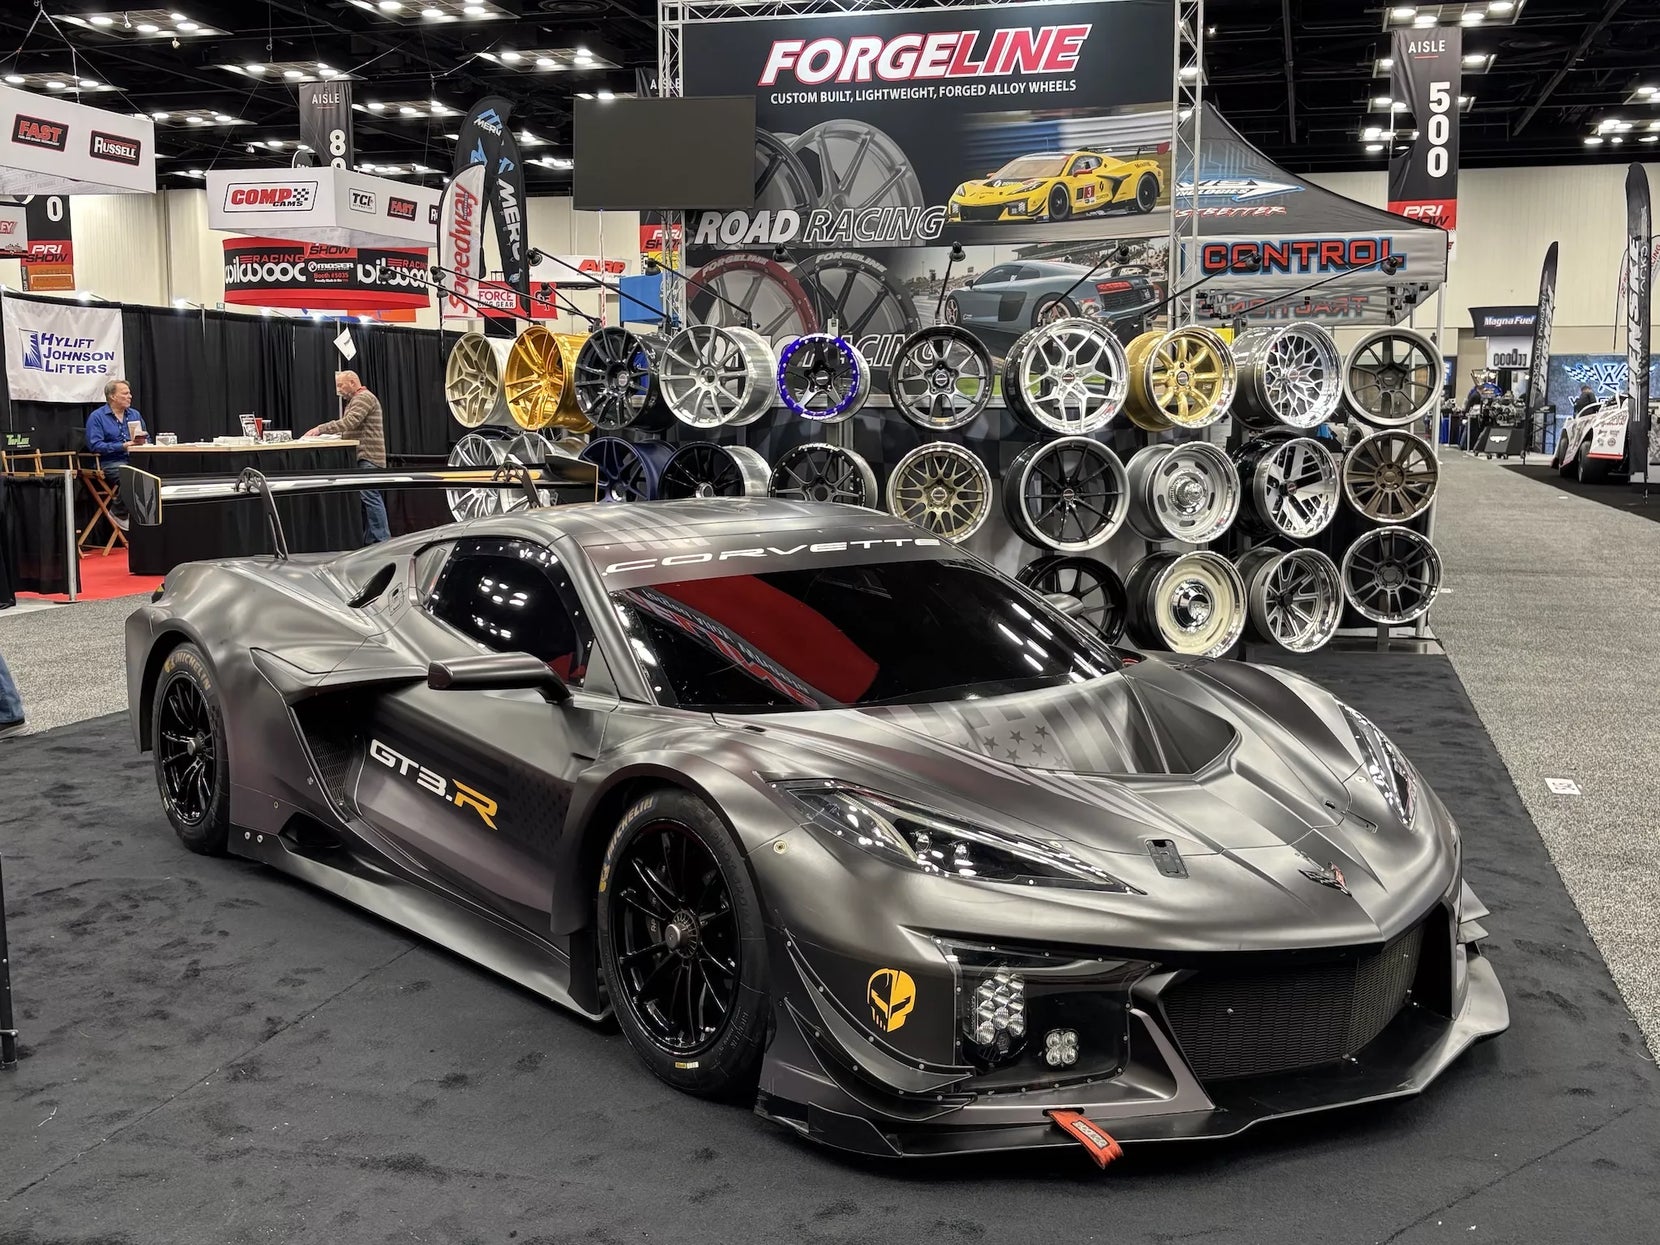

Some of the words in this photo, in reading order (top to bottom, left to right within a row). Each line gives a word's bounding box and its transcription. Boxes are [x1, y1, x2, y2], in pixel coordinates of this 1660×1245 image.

[758, 23, 1092, 87] FORGELINE
[1408, 39, 1446, 54] AISLE
[650, 78, 680, 90] ASLE
[770, 91, 817, 104] CUSTOM
[820, 89, 853, 103] BUILT,
[855, 86, 937, 102] LIGHTWEIGHT,
[939, 84, 985, 98] FORGED
[988, 82, 1026, 96] ALLOY
[1028, 79, 1077, 94] WHEELS
[312, 93, 340, 105] AISLE
[19, 120, 63, 143] FAST
[1427, 81, 1451, 178] 500
[94, 136, 136, 158] RUSSELL
[231, 188, 293, 205] COMP
[1402, 204, 1444, 217] PRI
[694, 209, 801, 245] ROAD
[802, 205, 948, 244] RACING
[31, 244, 63, 254] PRI
[309, 245, 351, 255] SHOW
[449, 182, 479, 313] Speedway
[1202, 237, 1406, 276] CONTROL
[26, 253, 68, 263] SHOW
[252, 254, 305, 263] RACING
[578, 259, 626, 274] ARP
[702, 253, 769, 277] FORGELINE
[815, 251, 888, 273] FORGELINE
[478, 290, 513, 302] FORCE
[41, 332, 95, 349] HYLIFT
[43, 347, 115, 361] JOHNSON
[45, 361, 108, 374] LIFTERS
[605, 538, 941, 575] CORVETTE
[175, 653, 212, 691] MICHELIN
[369, 738, 498, 830] GT3.R
[607, 796, 655, 860] MICHELIN
